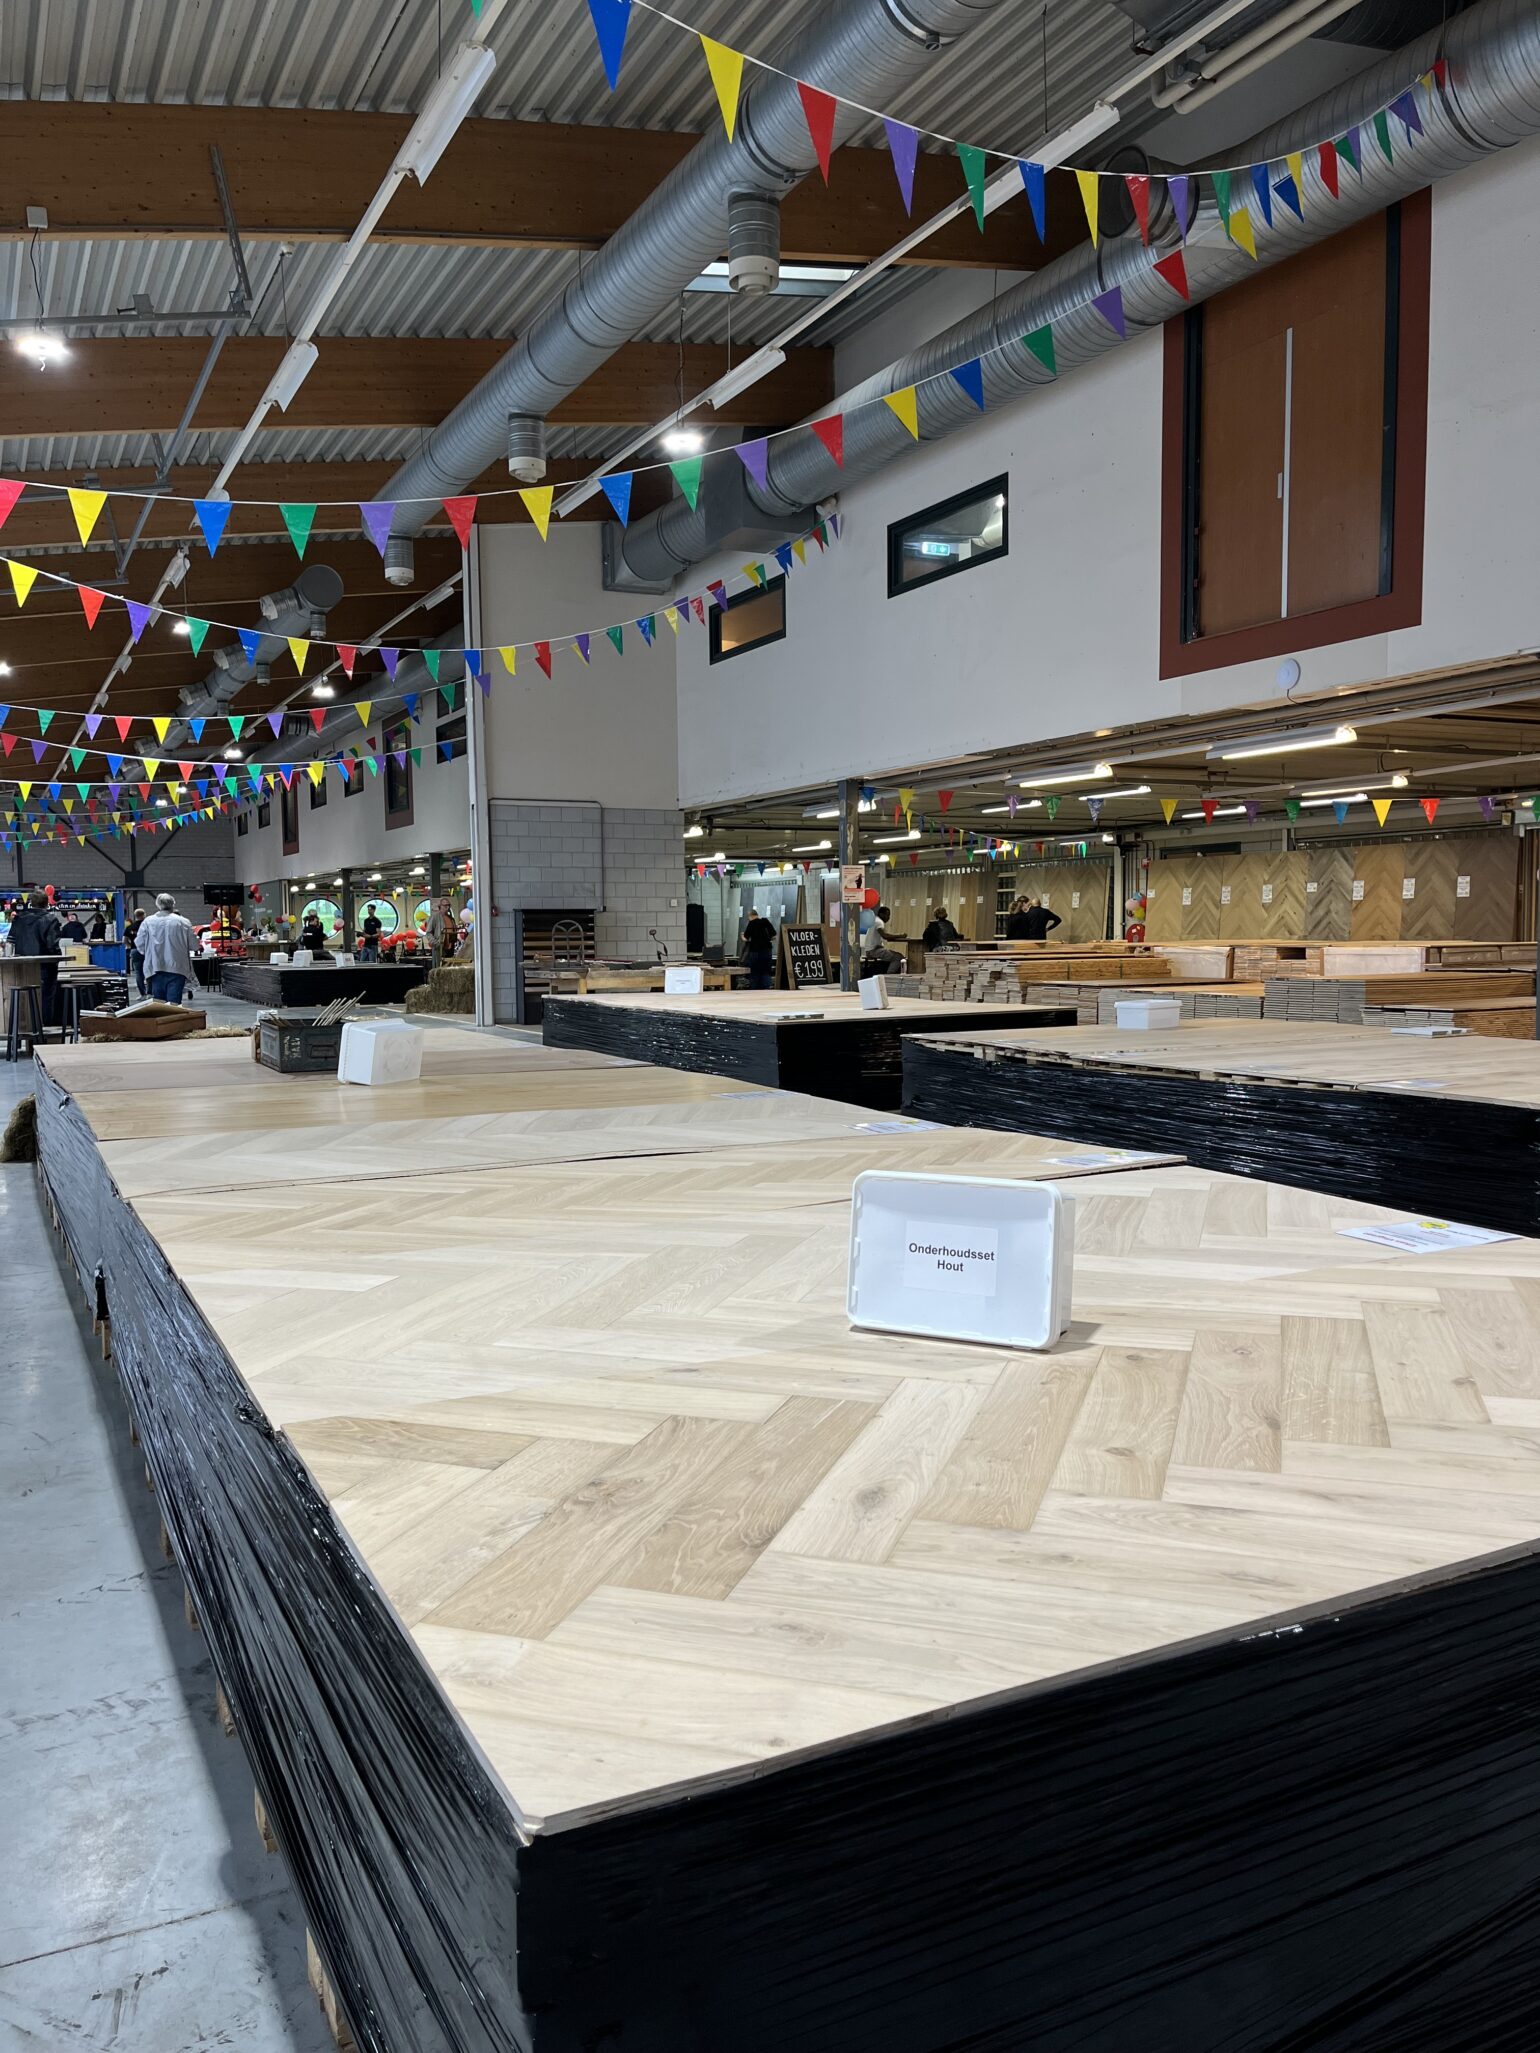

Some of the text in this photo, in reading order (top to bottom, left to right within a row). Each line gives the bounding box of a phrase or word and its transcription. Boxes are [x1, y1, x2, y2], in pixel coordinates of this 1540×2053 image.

[790, 931, 818, 941] VLOER-
[791, 944, 820, 956] KLEDEN
[794, 960, 824, 978] €199
[908, 1242, 995, 1261] Onderhoudsset
[937, 1259, 964, 1272] Hout
